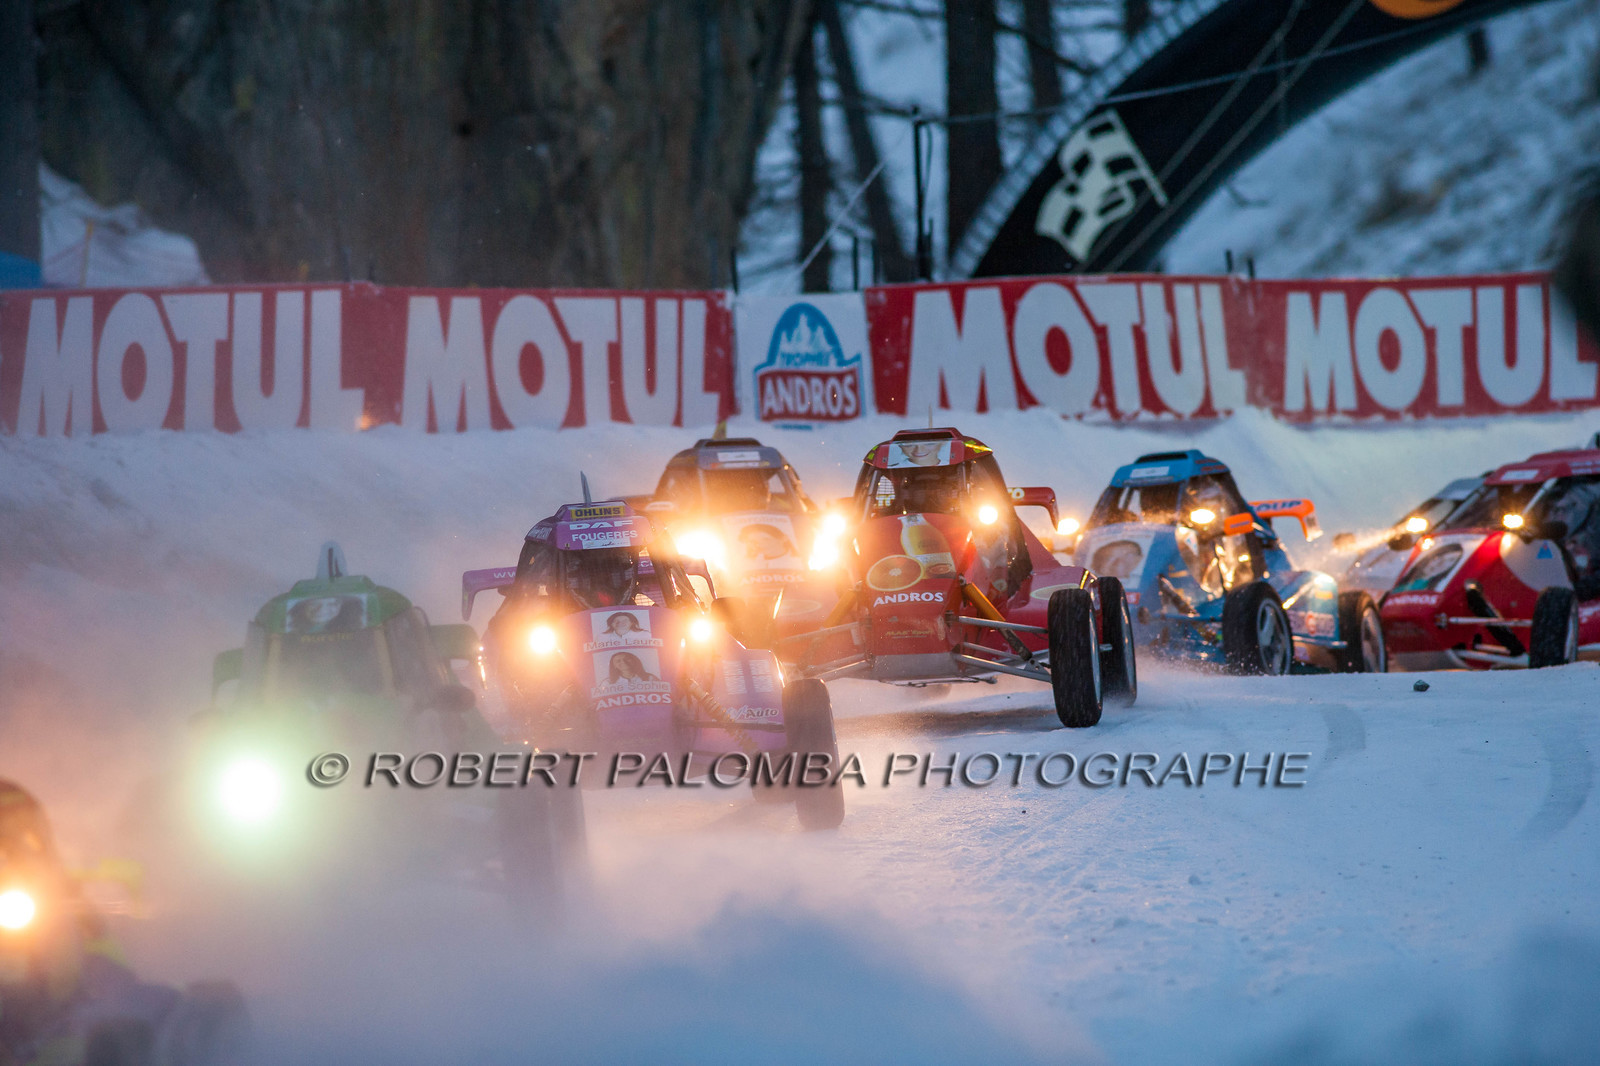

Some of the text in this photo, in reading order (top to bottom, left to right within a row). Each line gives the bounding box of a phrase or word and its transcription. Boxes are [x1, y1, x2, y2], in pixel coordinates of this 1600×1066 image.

[905, 282, 1247, 420] MOTUL
[1284, 284, 1597, 411] MOTUL
[15, 289, 366, 437] MOTUL
[401, 294, 720, 432] MOTUL
[763, 376, 857, 417] ANDROS
[569, 520, 633, 531] DAF
[572, 530, 638, 542] FOUGERES
[740, 573, 806, 585] ANDROS
[873, 592, 944, 608] ANDROS
[585, 638, 661, 651] Marie Laure
[593, 680, 669, 695] Anne Sophie
[596, 693, 672, 711] ANDROS
